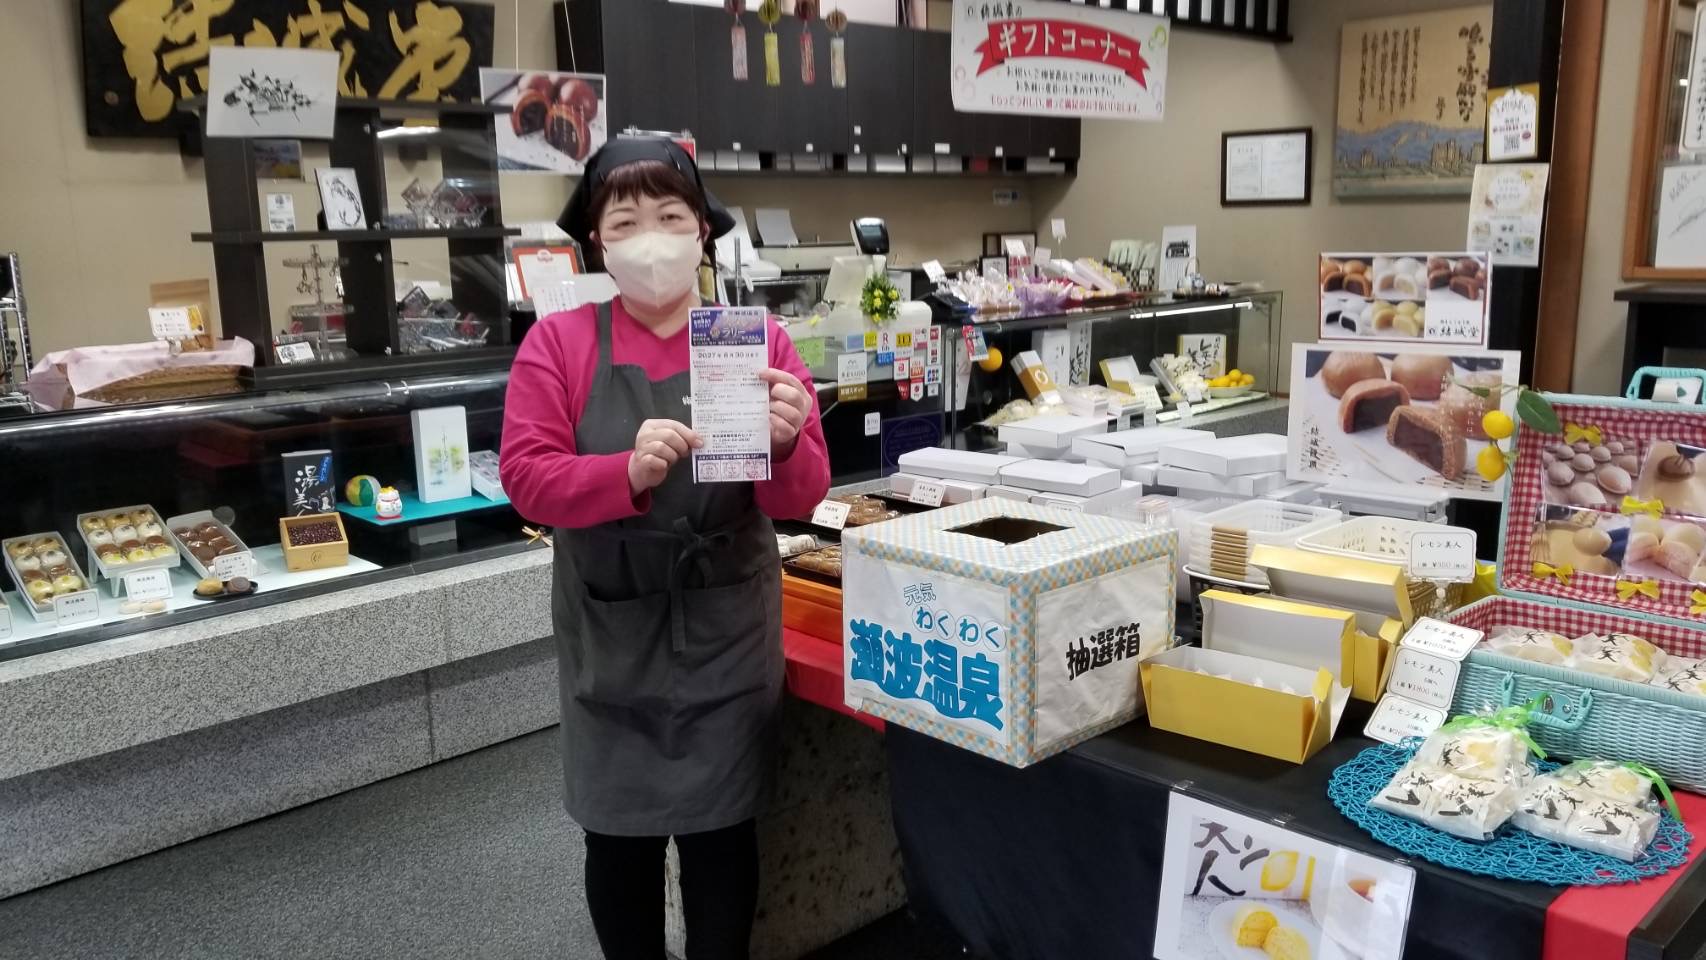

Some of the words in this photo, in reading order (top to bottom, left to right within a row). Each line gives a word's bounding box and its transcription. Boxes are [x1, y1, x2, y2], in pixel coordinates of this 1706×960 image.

[998, 23, 1132, 62] ギフトコーナー
[903, 582, 937, 606] 元気
[914, 605, 1001, 650] わくわく
[1065, 622, 1141, 681] 抽選箱
[1404, 659, 1444, 676] レモン美人
